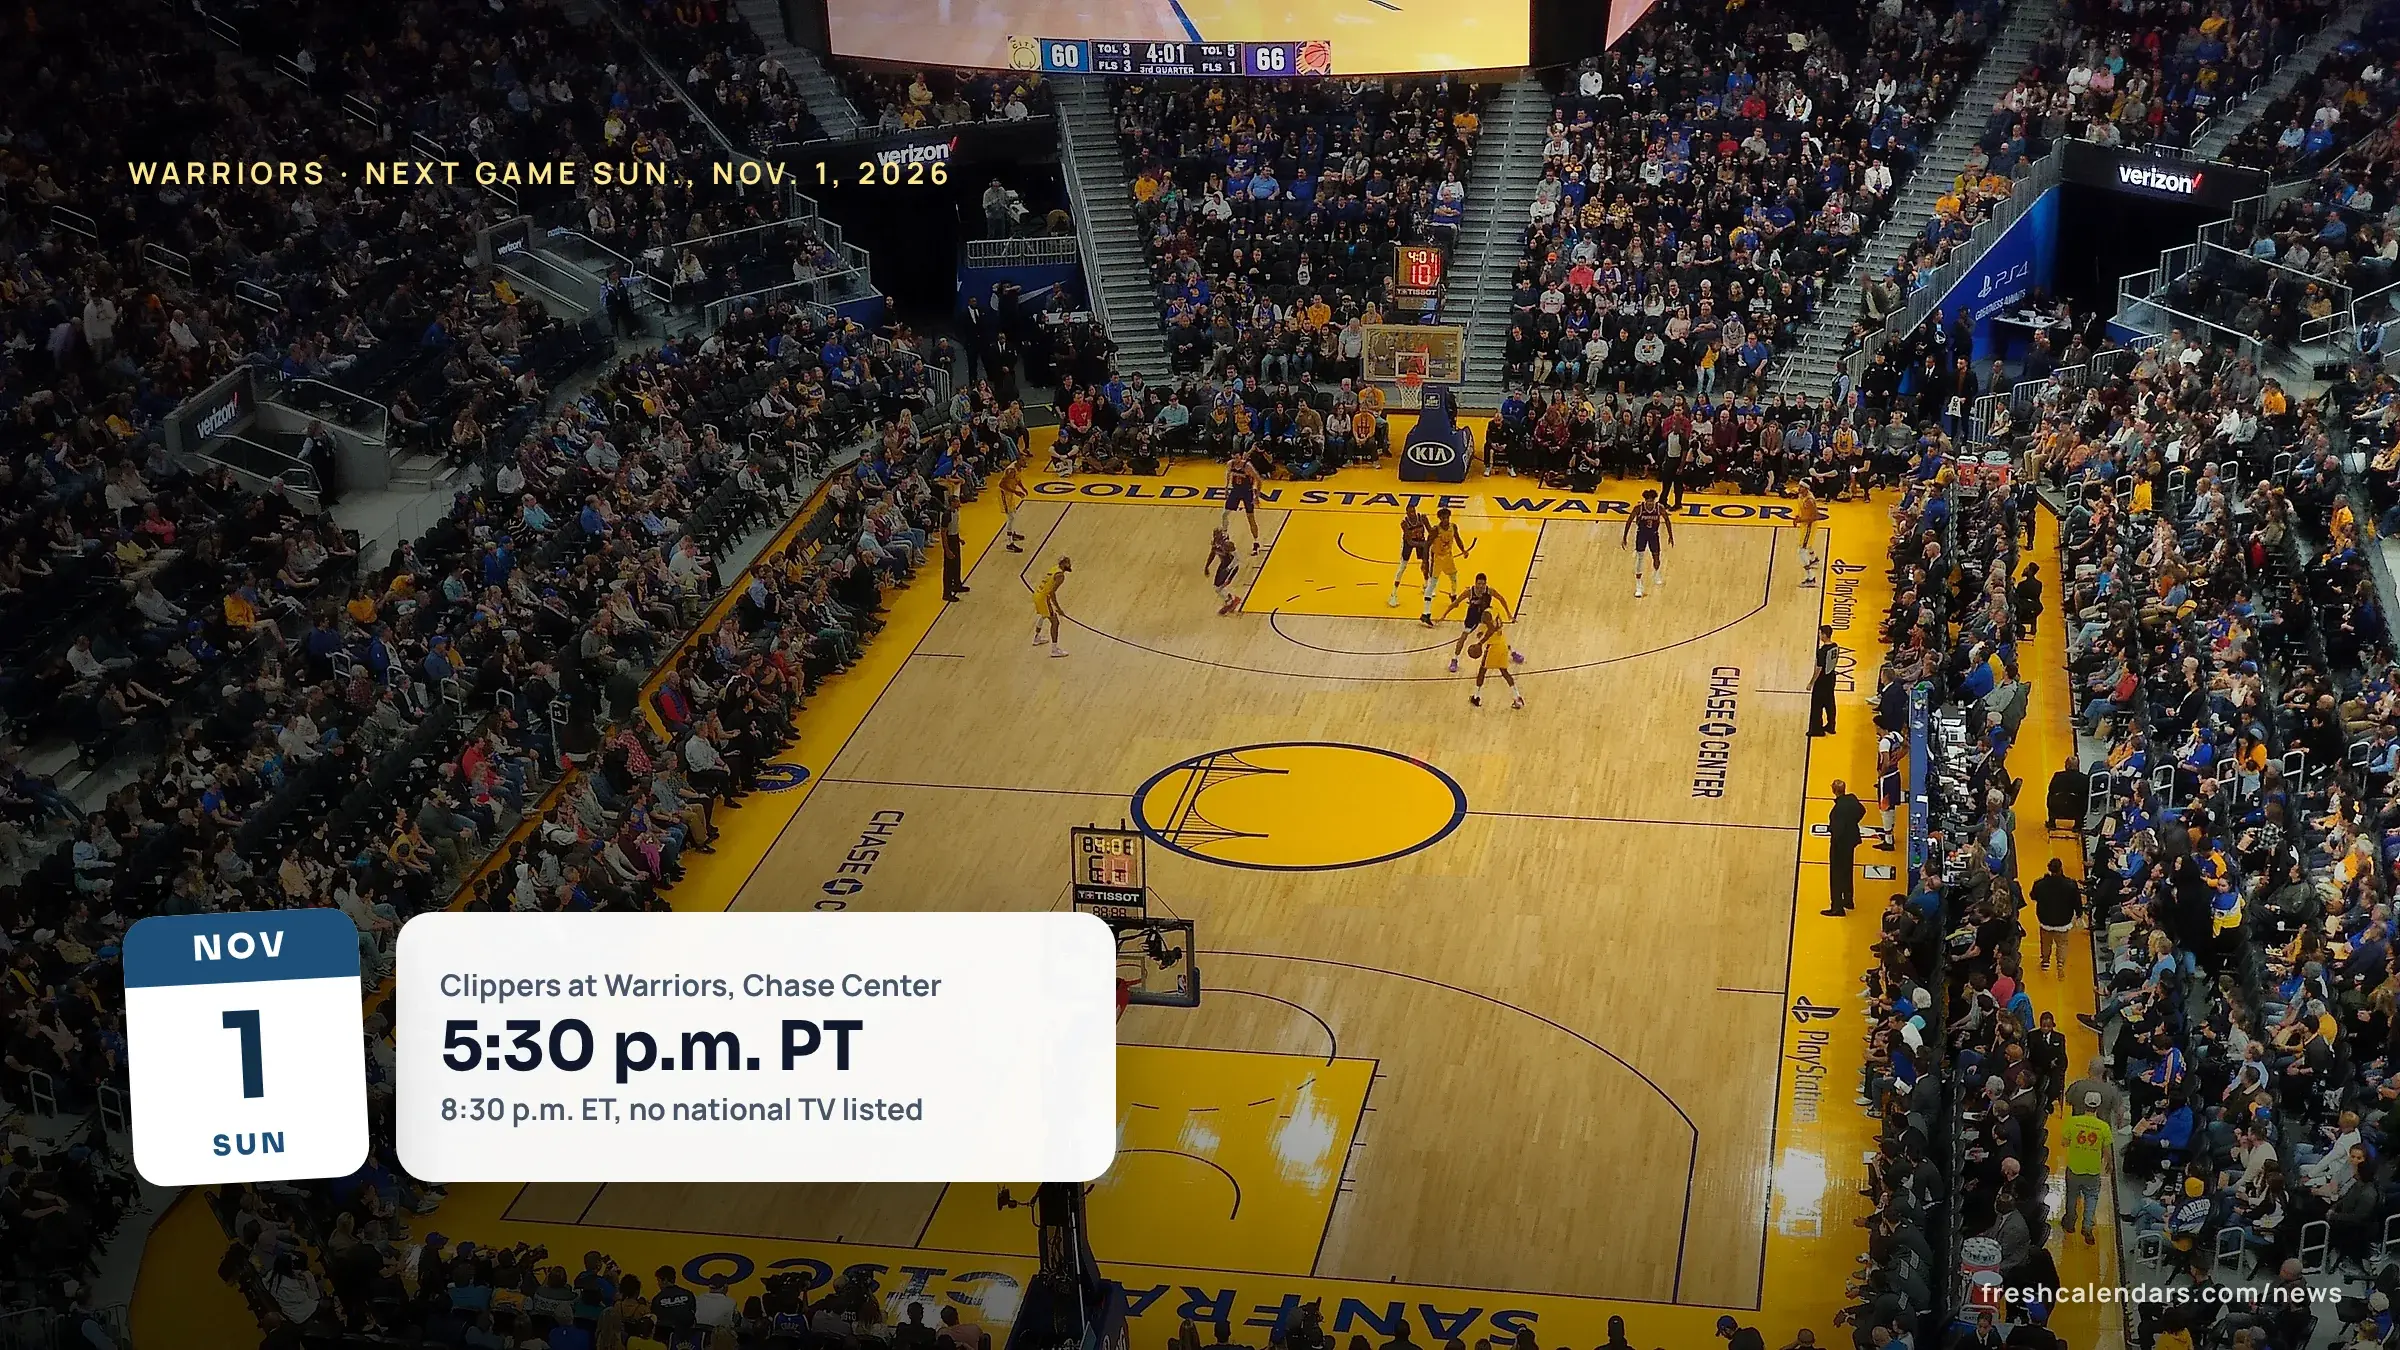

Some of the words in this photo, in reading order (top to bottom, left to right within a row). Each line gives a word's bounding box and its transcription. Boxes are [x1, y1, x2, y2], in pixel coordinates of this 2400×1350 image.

[1052, 44, 1077, 67] 60
[1097, 44, 1118, 54] TOL
[1122, 43, 1131, 55] 3
[1147, 43, 1185, 63] 4:01
[1201, 46, 1222, 56] TOL
[1227, 45, 1235, 57] 5
[1256, 48, 1284, 71] 66
[1098, 60, 1118, 71] FLS
[1123, 60, 1131, 72] 3
[1155, 66, 1194, 75] QUARTER
[1202, 62, 1222, 72] FLS
[1229, 62, 1236, 73] 1
[877, 143, 949, 166] verizon
[2119, 167, 2193, 194] verizon
[1408, 251, 1435, 264] 4:01
[1411, 264, 1432, 285] 10
[1995, 260, 2028, 289] PS4
[1408, 288, 1437, 297] TISSOT
[196, 405, 236, 438] verizon
[1415, 446, 1447, 461] KIA
[1032, 480, 1283, 502] GOLDEN
[1299, 490, 1471, 510] STATE
[1492, 496, 1830, 521] WARIOR
[1826, 578, 1859, 631] PlayStation
[1705, 666, 1740, 719] CHASE
[1692, 740, 1730, 799] CENTER
[836, 810, 905, 875] CHASE
[1094, 891, 1140, 902] TISSOT
[2076, 1130, 2098, 1147] 69
[1332, 1298, 1540, 1346] SAN
